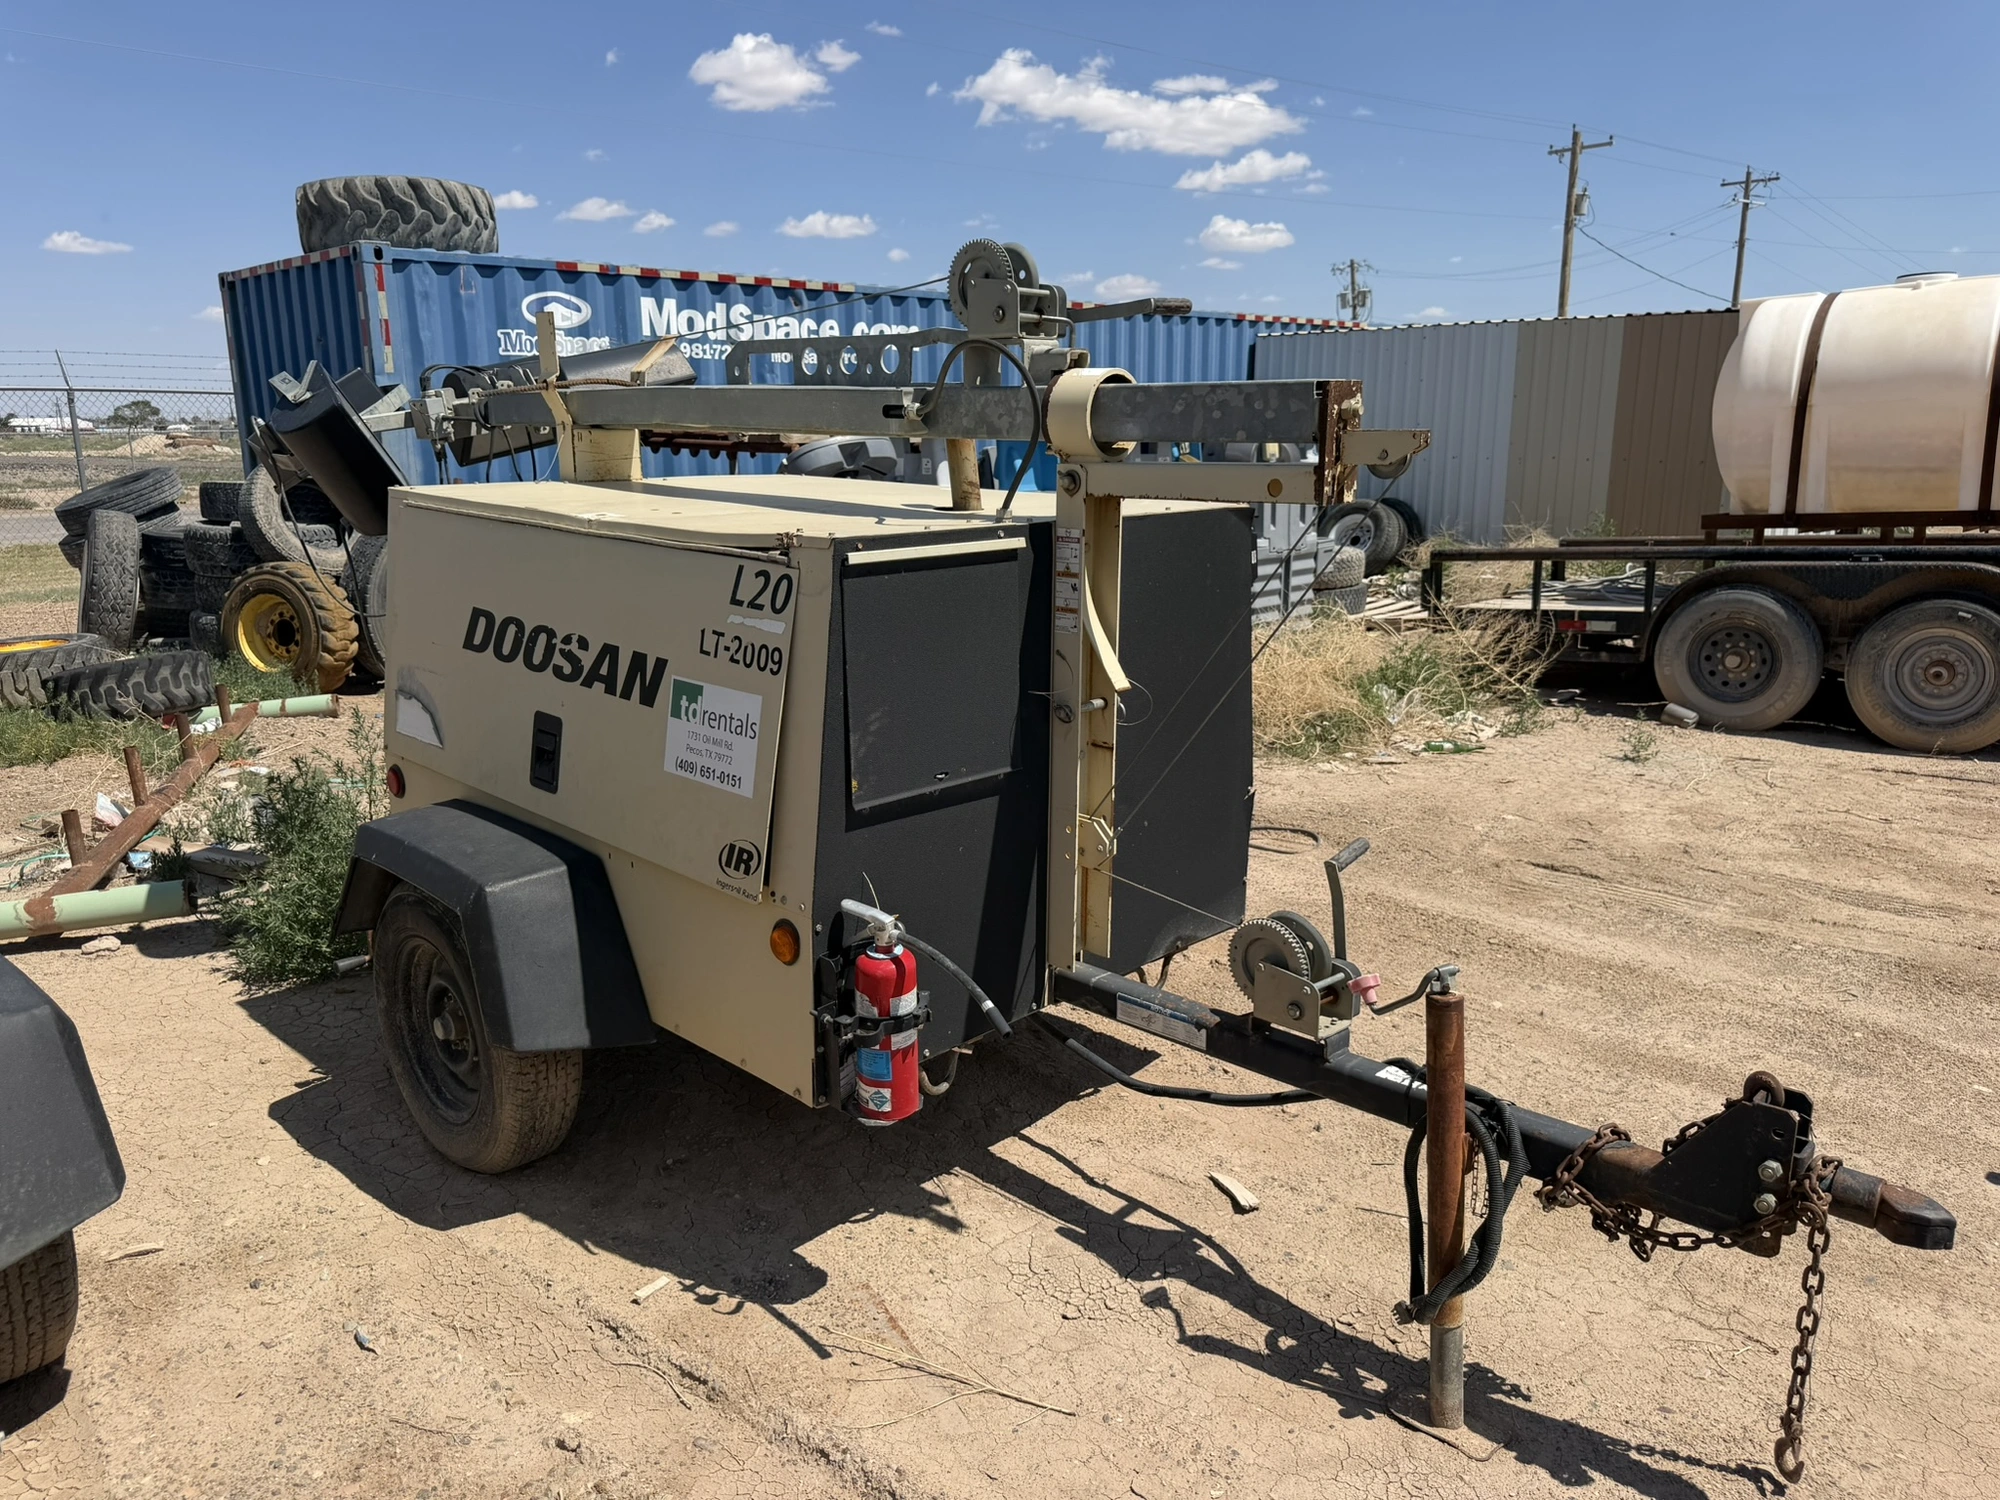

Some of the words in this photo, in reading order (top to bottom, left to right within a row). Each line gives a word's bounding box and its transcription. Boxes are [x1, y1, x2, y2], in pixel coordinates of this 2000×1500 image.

[729, 564, 793, 614] L20
[462, 606, 669, 708] DOOSAN
[700, 628, 783, 676] LT-2009
[686, 743, 704, 758] Pecos,
[705, 748, 714, 760] TX
[714, 752, 733, 766] 79772
[687, 730, 701, 742] 1731
[702, 734, 711, 745] Oil
[712, 736, 723, 748] Mill
[675, 756, 698, 777] (409)
[699, 765, 742, 789] 651-0151
